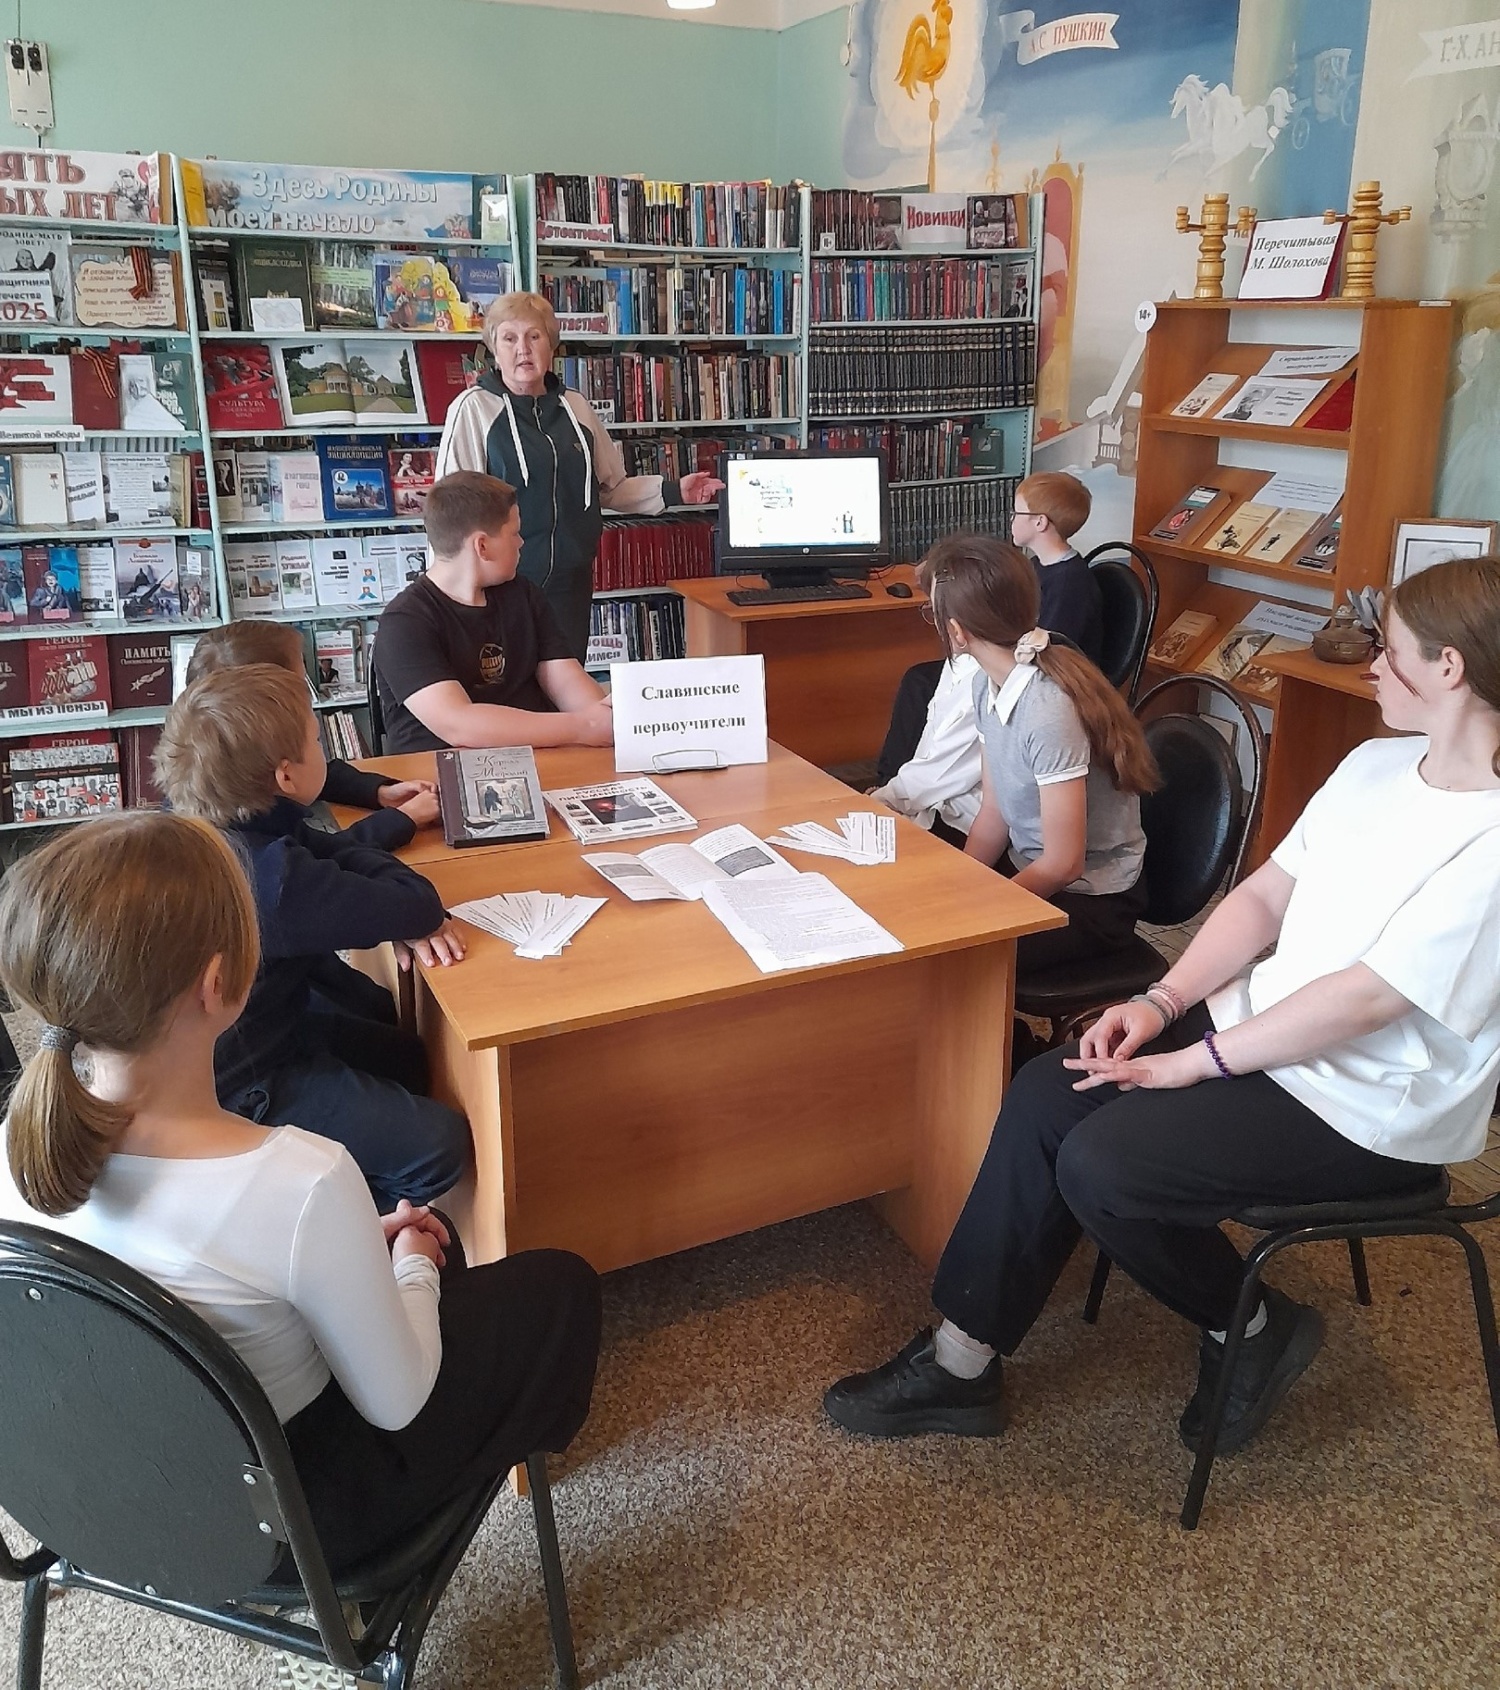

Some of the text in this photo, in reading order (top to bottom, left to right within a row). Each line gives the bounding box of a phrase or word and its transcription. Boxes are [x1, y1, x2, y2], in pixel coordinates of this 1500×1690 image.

[1053, 21, 1107, 45] ПУШКИН
[60, 190, 119, 221] ЛЕТ
[207, 203, 375, 233] моей начало
[907, 205, 966, 230] Новинки
[1254, 235, 1337, 253] Перечитывая
[1250, 255, 1330, 270] М. Шолохова
[0, 302, 48, 321] 025
[124, 646, 171, 660] ПАМЯТЬ
[641, 683, 740, 700] Славянские
[633, 715, 746, 736] первоучители
